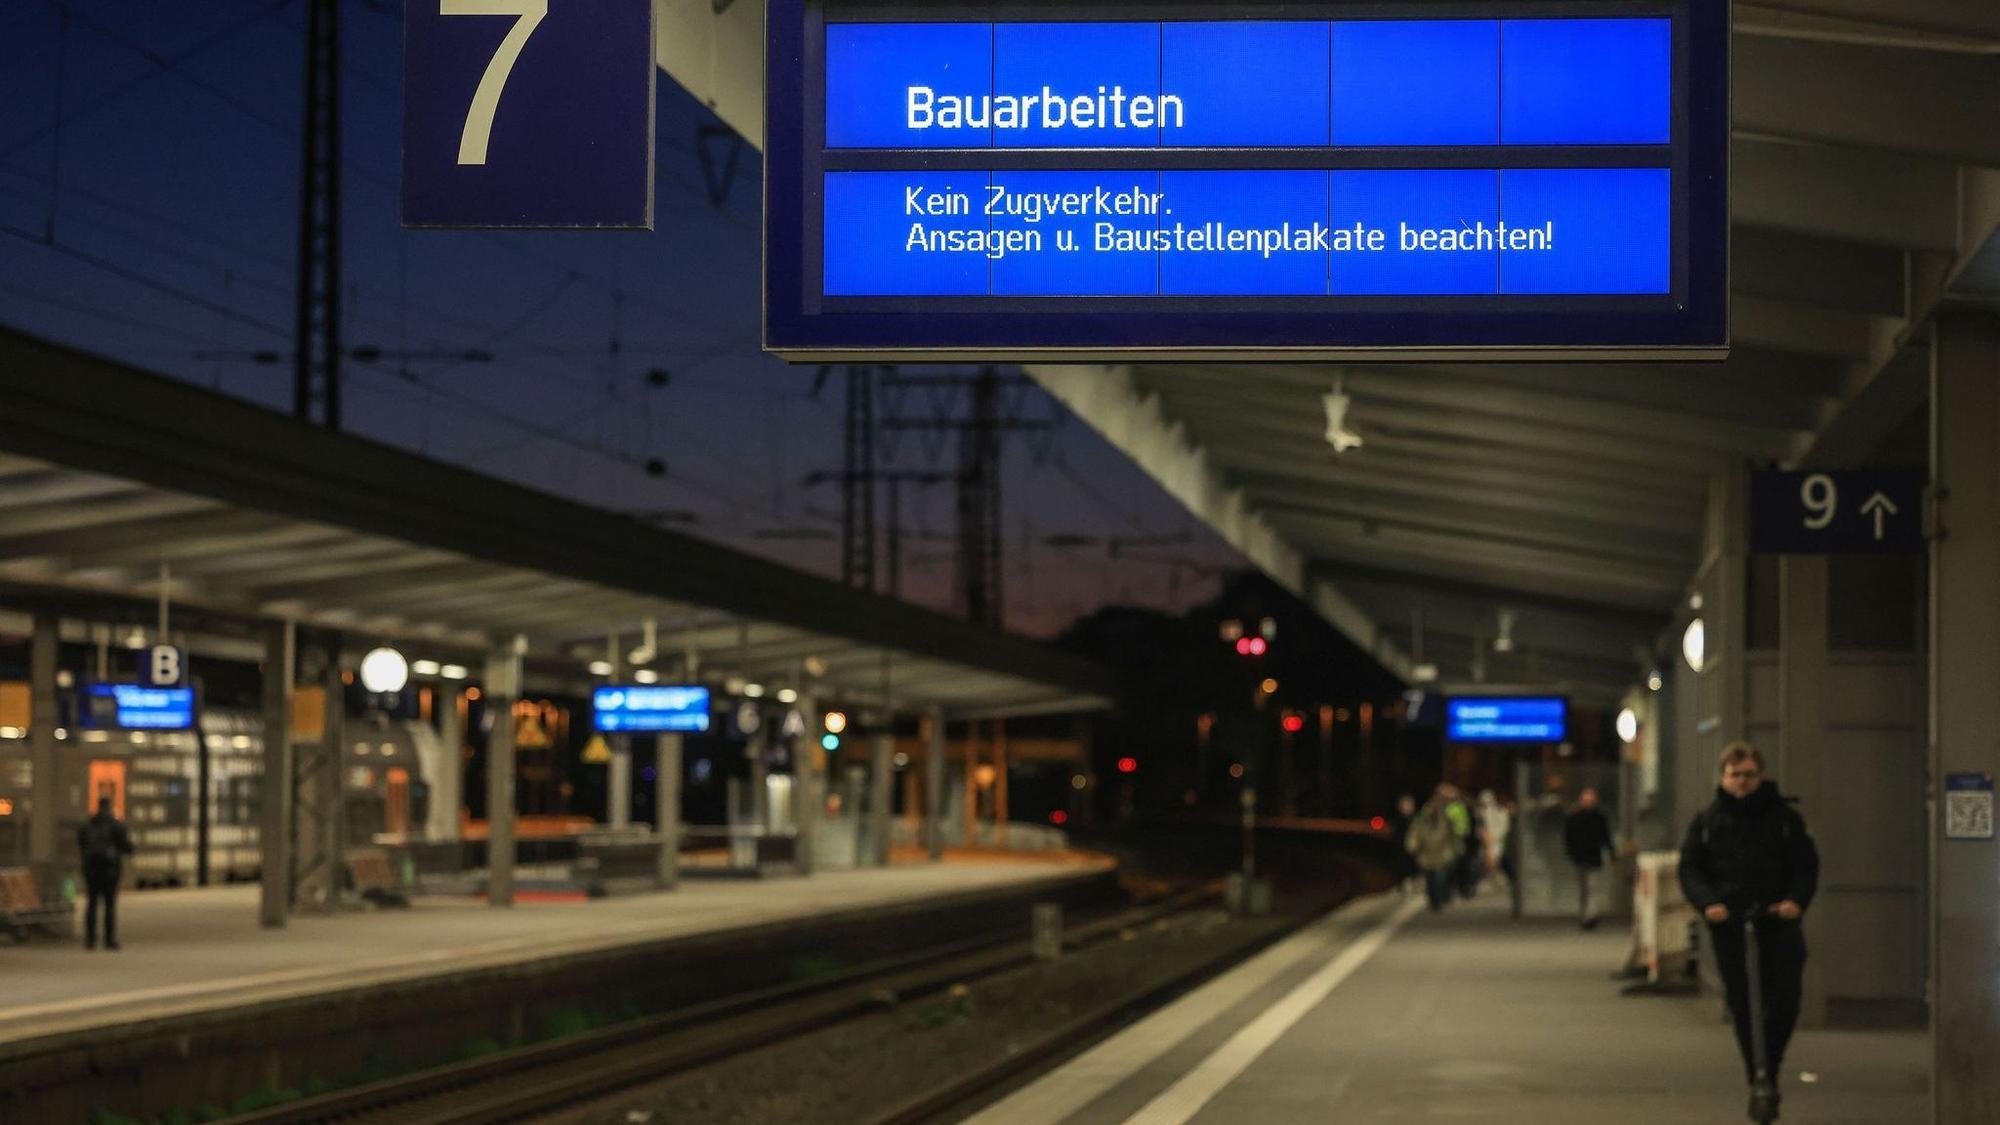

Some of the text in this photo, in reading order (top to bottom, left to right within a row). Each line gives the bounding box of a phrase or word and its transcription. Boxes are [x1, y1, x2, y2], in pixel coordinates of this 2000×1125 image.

[440, 0, 548, 165] 7
[907, 86, 1184, 129] Bauarbeiten
[905, 186, 1172, 222] Kein Zugverkehr.
[905, 222, 1552, 258] Ansagen u. Baustellenplakate beachten!
[1800, 473, 1838, 530] 9
[151, 645, 180, 685] B
